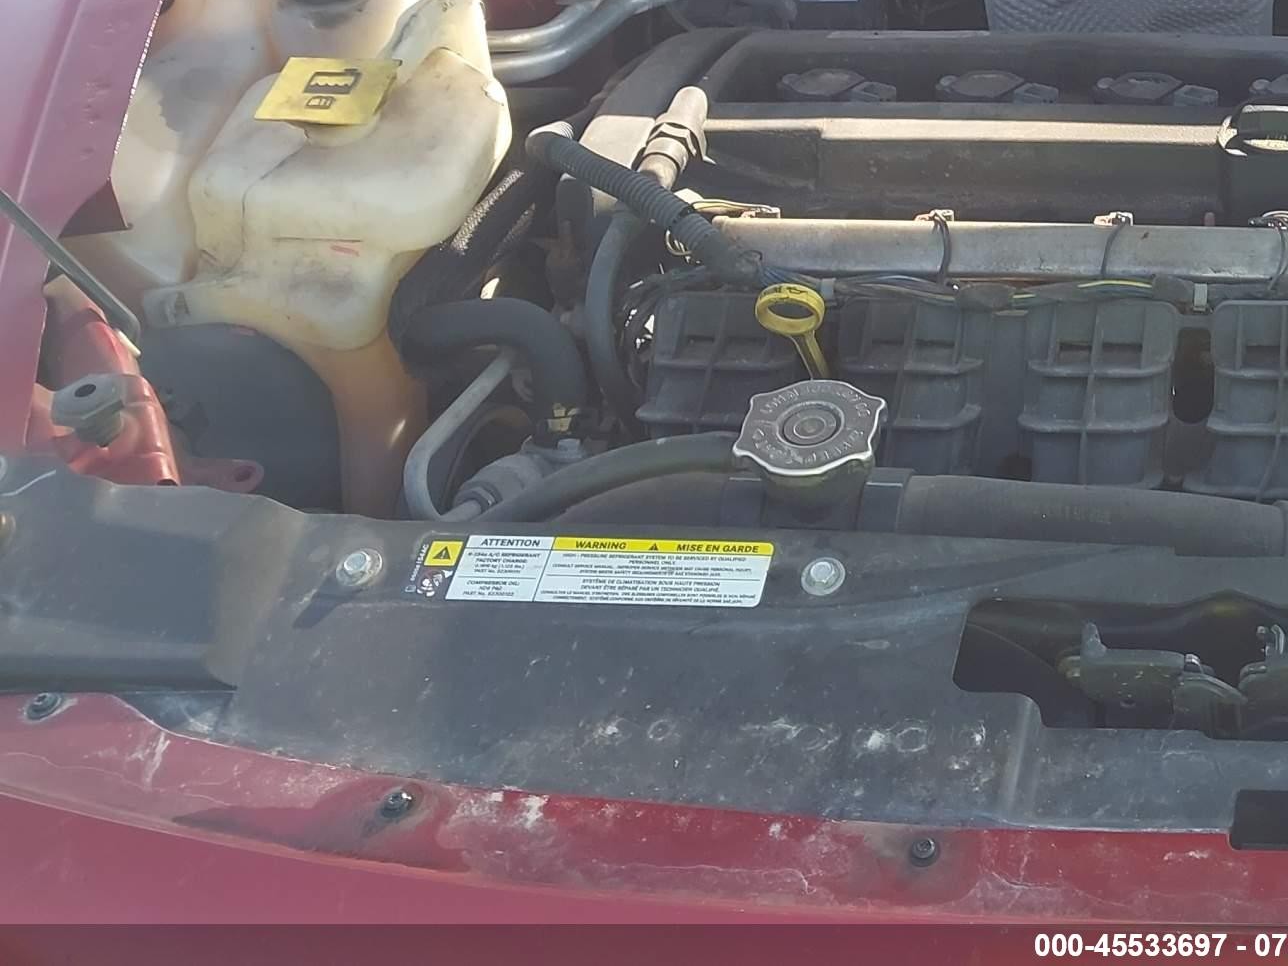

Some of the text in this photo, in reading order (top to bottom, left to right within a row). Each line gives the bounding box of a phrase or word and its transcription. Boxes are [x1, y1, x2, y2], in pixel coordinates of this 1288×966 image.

[480, 538, 541, 547] ATTENTION
[575, 540, 627, 550] WARNING
[676, 544, 760, 554] MISE EN GARDE
